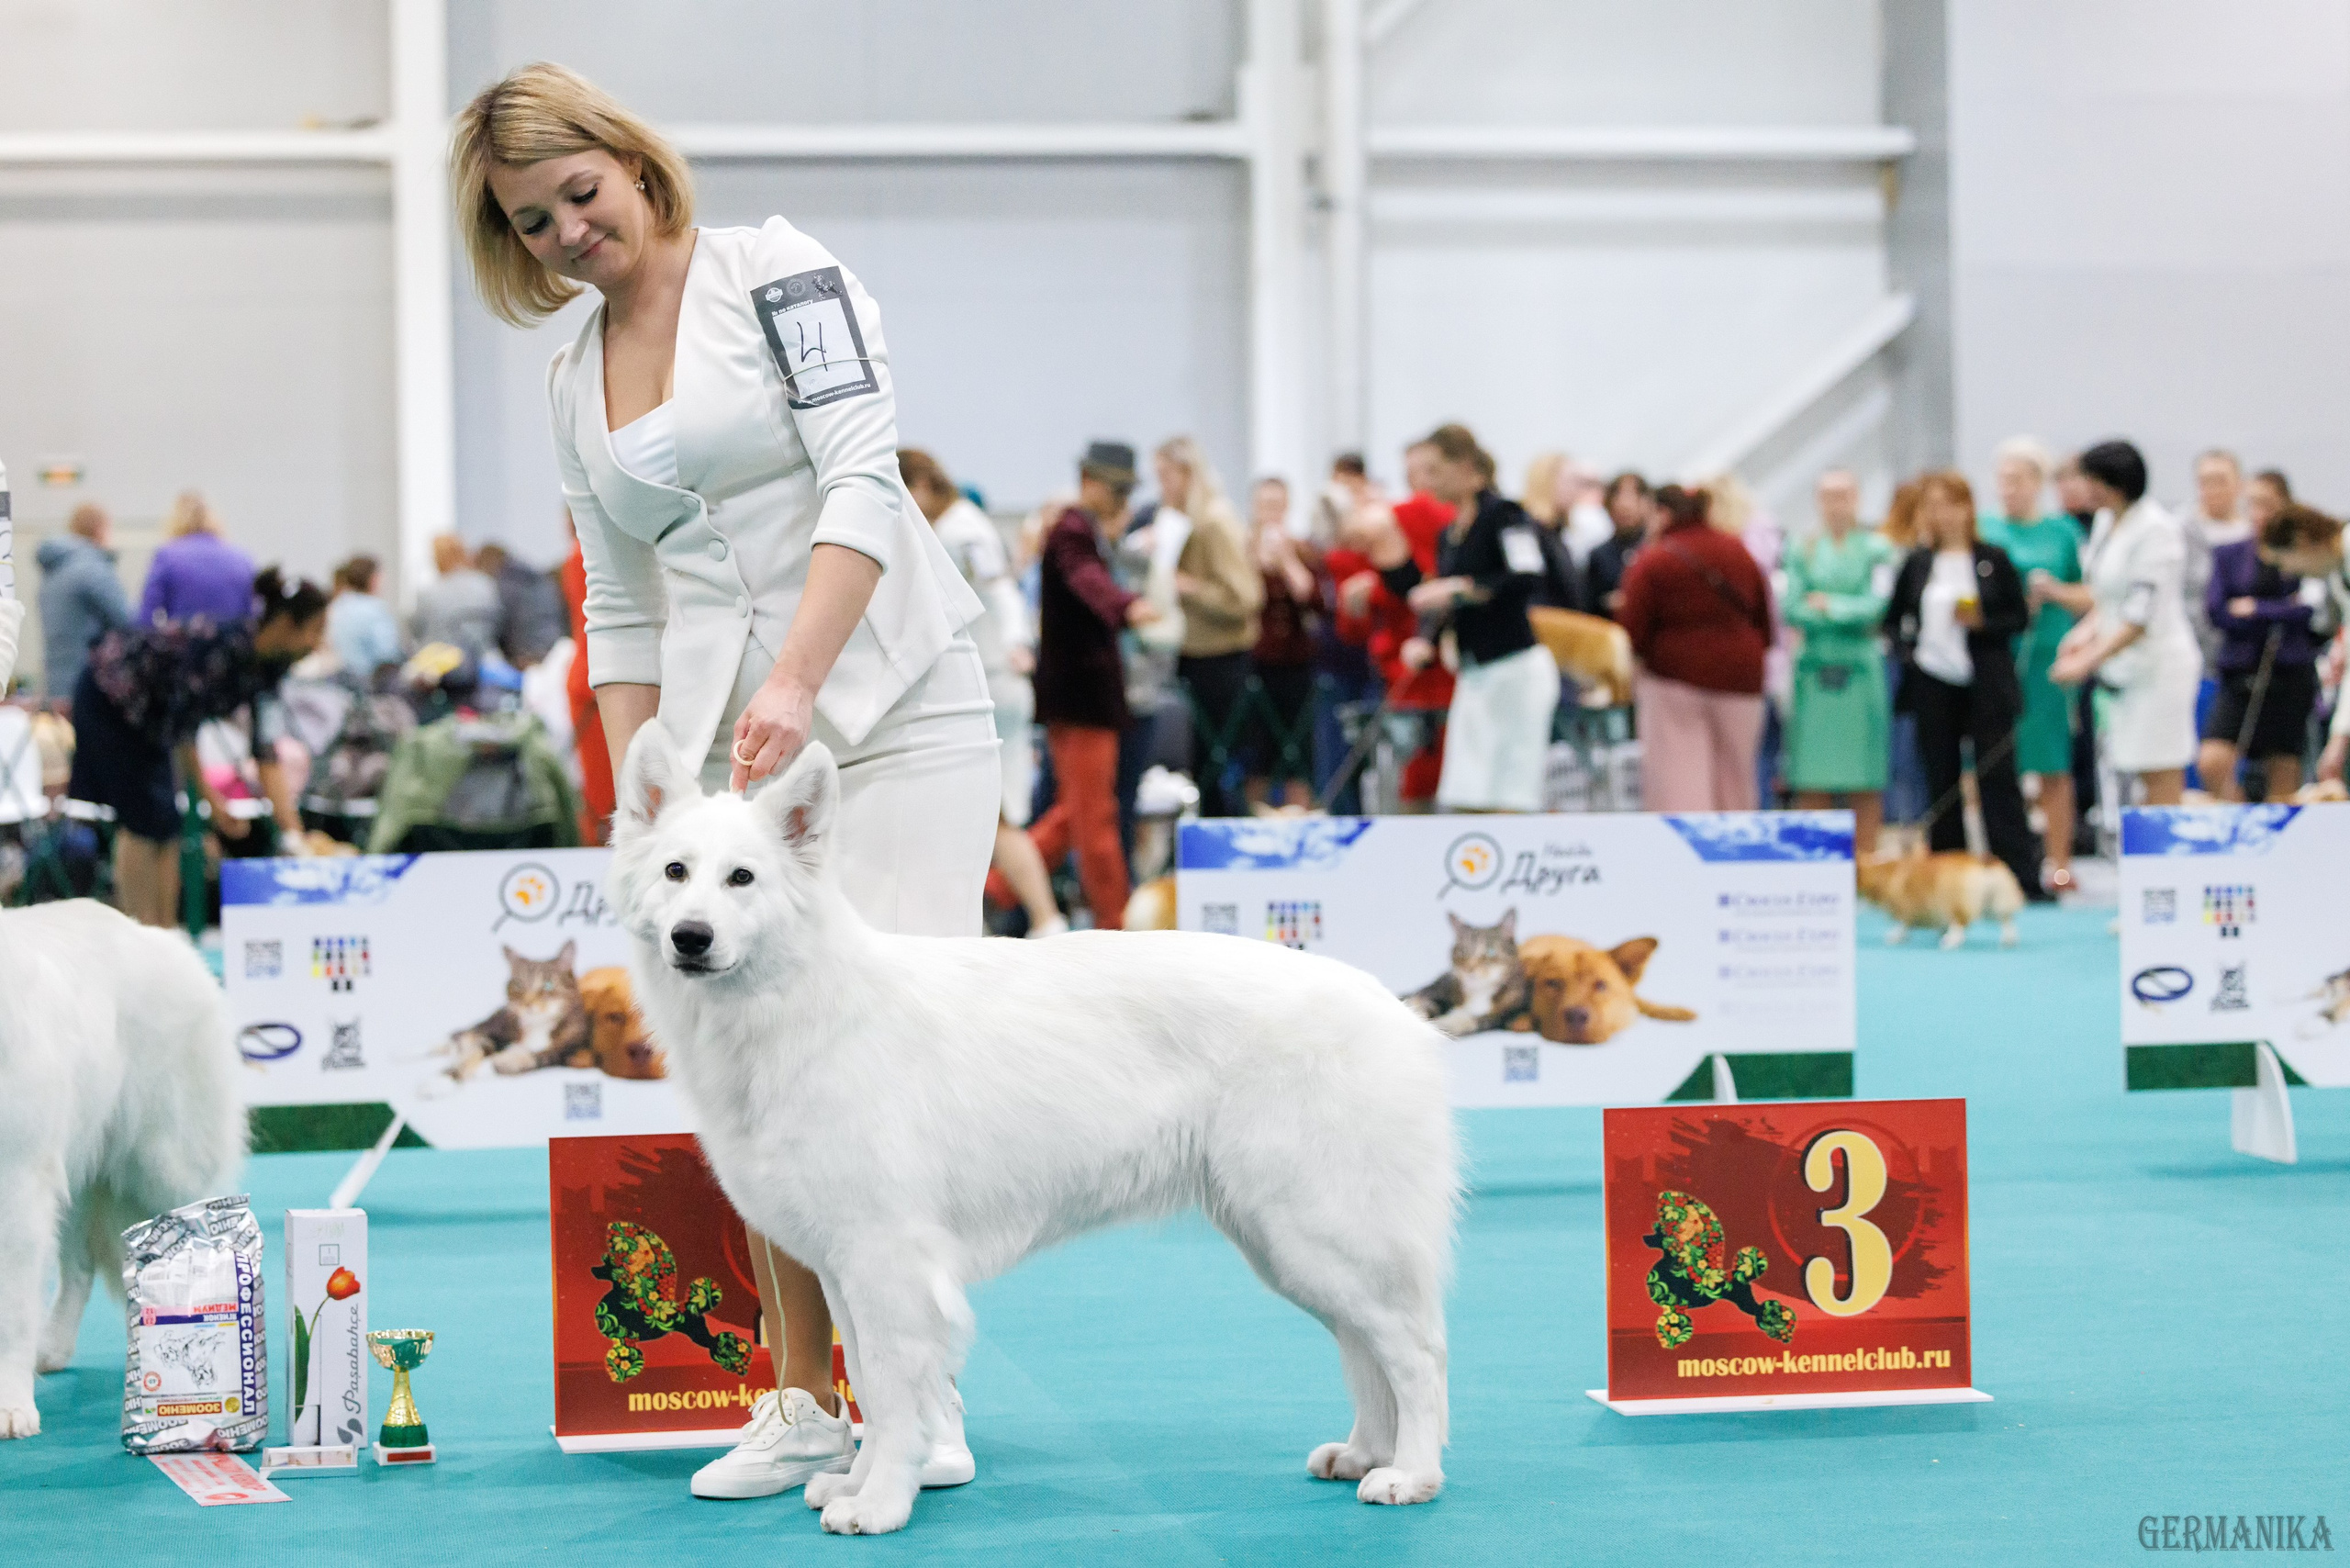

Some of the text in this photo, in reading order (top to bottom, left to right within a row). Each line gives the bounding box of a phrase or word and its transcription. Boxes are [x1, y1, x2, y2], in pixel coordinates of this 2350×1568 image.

[786, 298, 813, 311] каталогу
[796, 321, 829, 372] 4
[1499, 851, 1601, 896] Друга
[1803, 1128, 1894, 1317] 3
[194, 1304, 237, 1313] МЕДИУМ
[235, 1252, 255, 1413] ПРОФЕССИОНАЛ
[343, 1303, 361, 1415] Paşabahçe
[1676, 1346, 1952, 1378] moscow-kennelclub.ru
[159, 1404, 221, 1415] ЗООМЕНЮ
